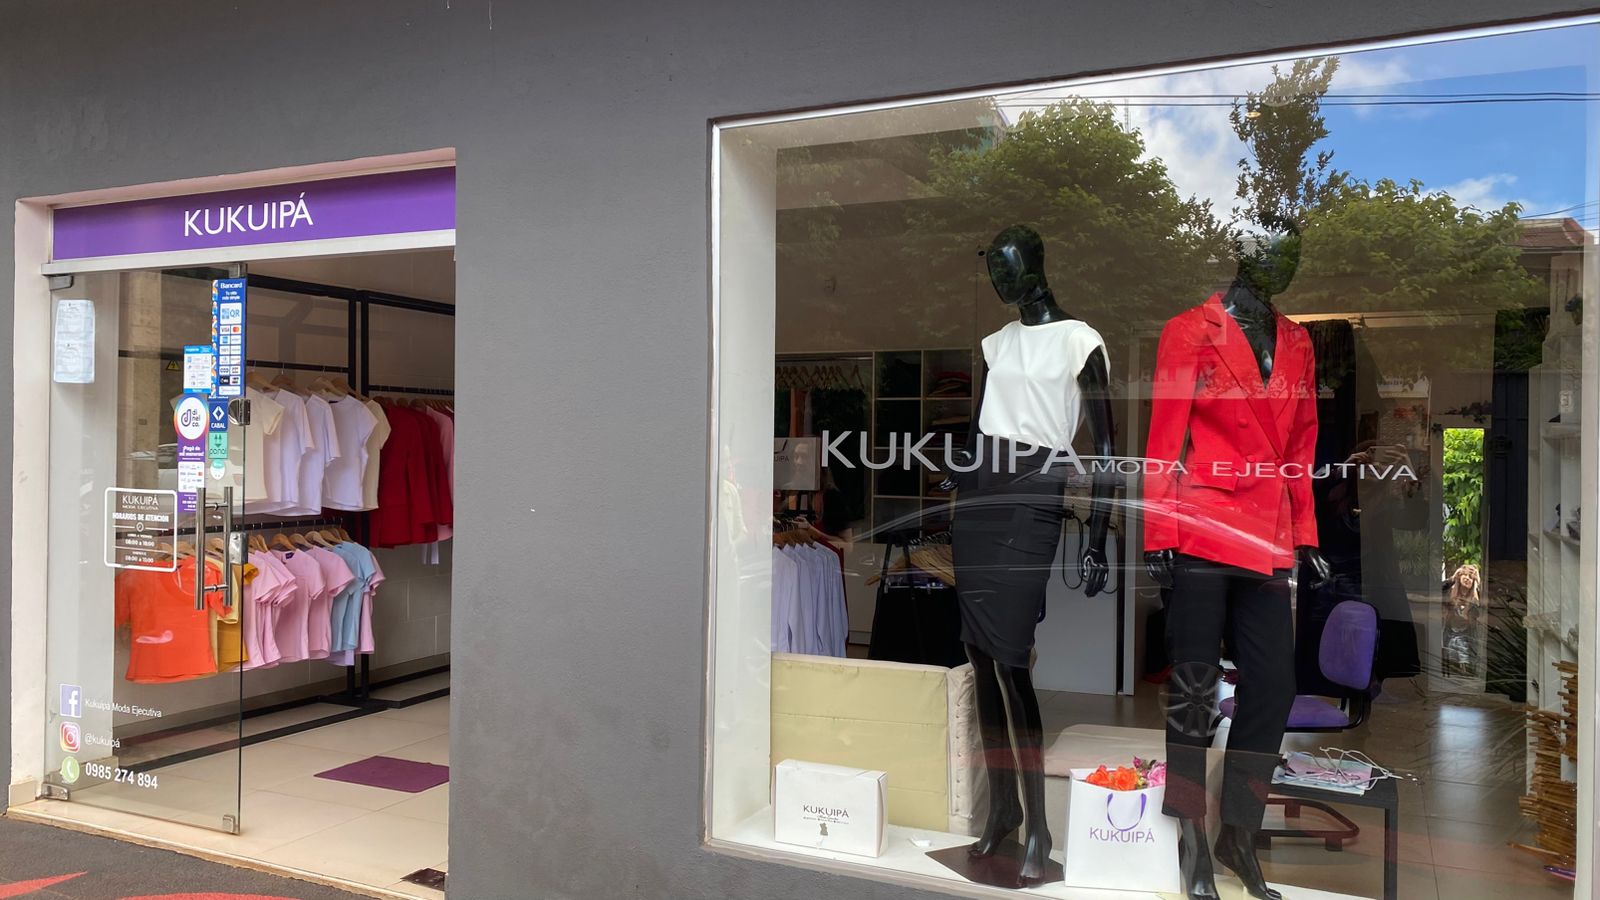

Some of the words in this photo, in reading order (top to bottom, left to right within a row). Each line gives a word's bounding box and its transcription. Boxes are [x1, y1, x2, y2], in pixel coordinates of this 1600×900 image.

[184, 191, 314, 237] KUKUIPÁ
[230, 309, 240, 318] QR
[1091, 460, 1189, 475] MODA
[1212, 461, 1418, 481] EJECUTIVA
[122, 494, 159, 506] KUKUIPÁ
[137, 513, 145, 521] DE
[111, 702, 131, 714] Moda
[131, 705, 162, 718] Ejecutiva
[85, 762, 112, 780] 0985
[114, 768, 134, 784] 274
[137, 773, 158, 789] 894
[1089, 826, 1155, 843] KUKUIPÁ
